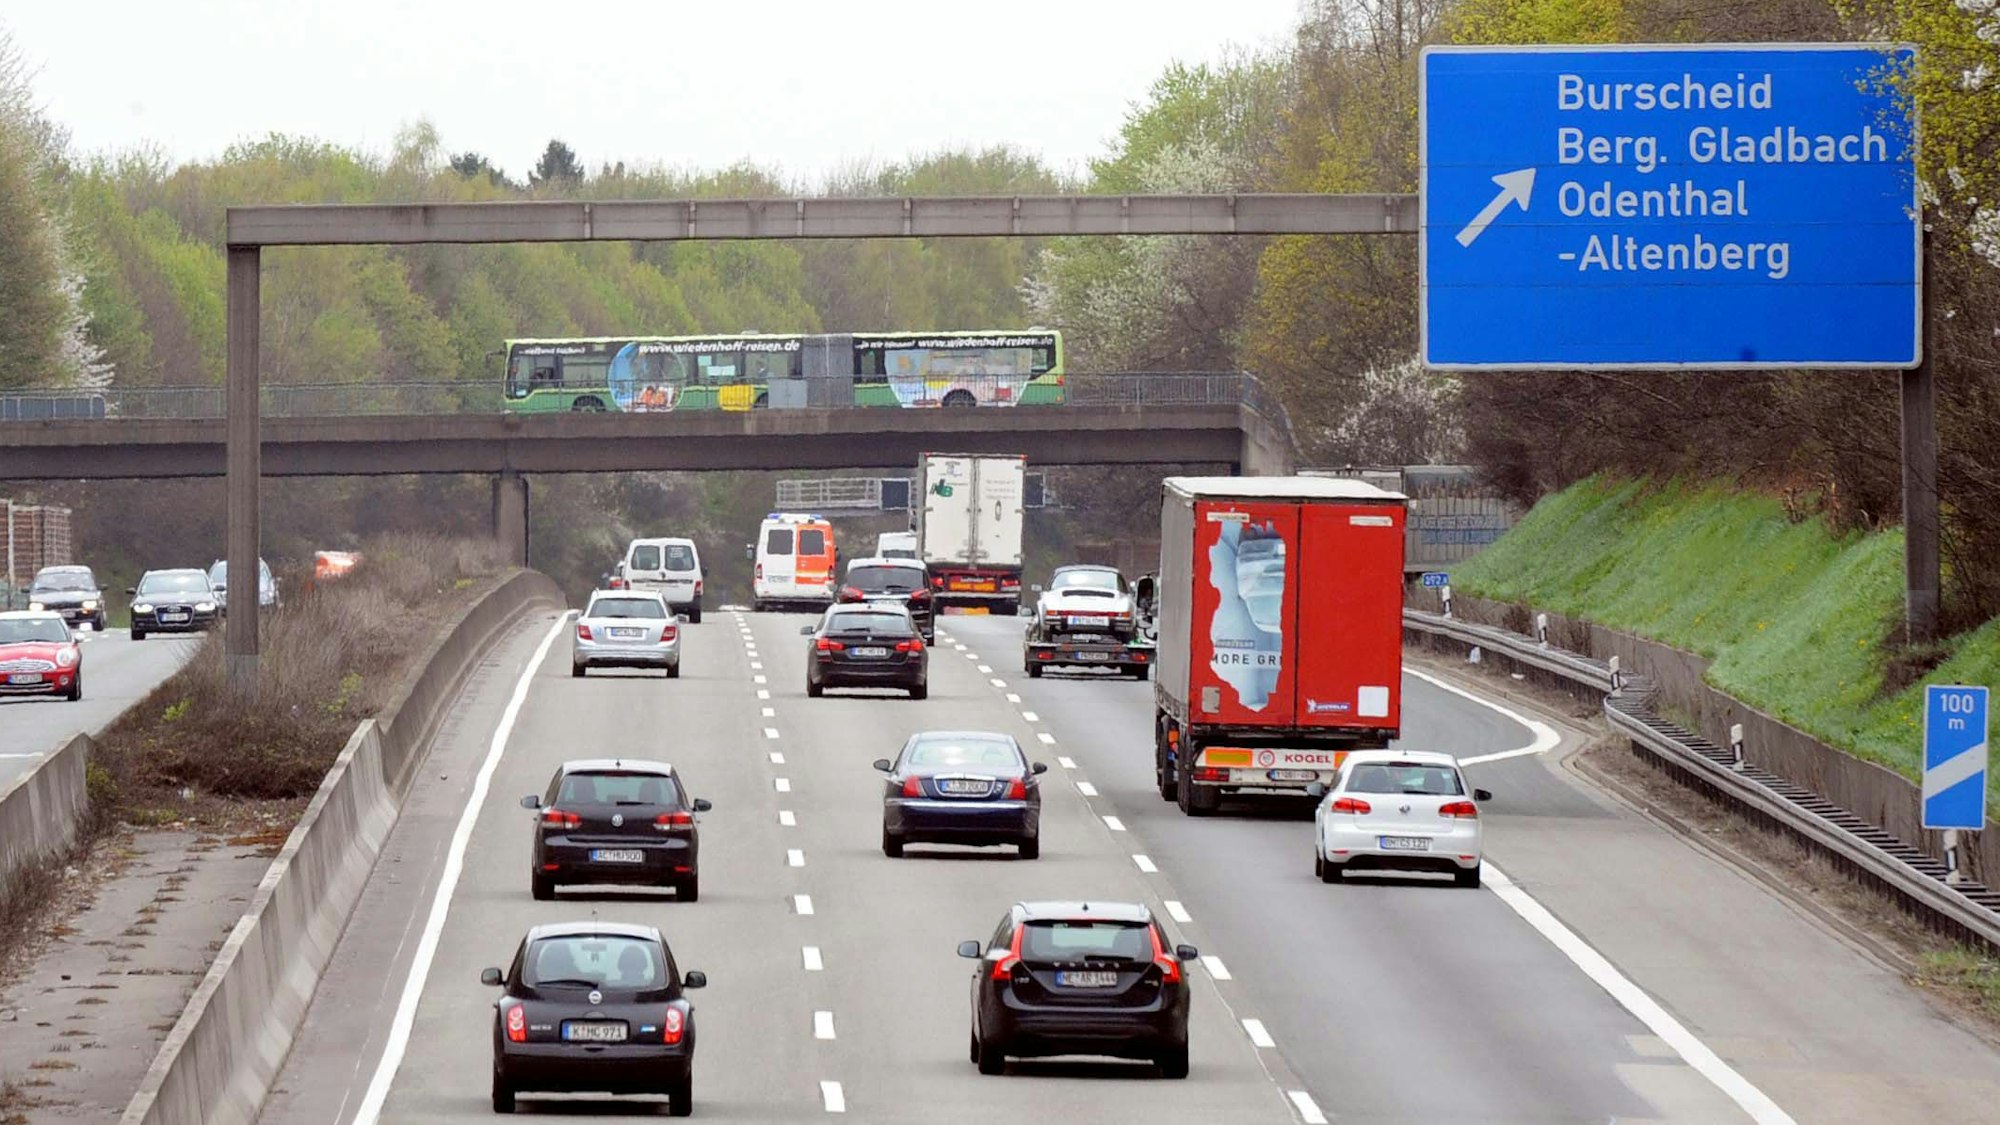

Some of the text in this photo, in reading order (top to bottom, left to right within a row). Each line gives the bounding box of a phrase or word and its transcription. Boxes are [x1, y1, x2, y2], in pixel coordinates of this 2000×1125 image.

[1558, 73, 1772, 110] Burscheid
[1558, 125, 1887, 173] Berg. Gladbach
[1558, 180, 1748, 217] Odenthal
[1558, 234, 1790, 279] -Altenberg
[639, 339, 800, 353] www.wiedenhoff-reisen.de
[1940, 693, 1975, 714] 100
[1948, 718, 1965, 730] m
